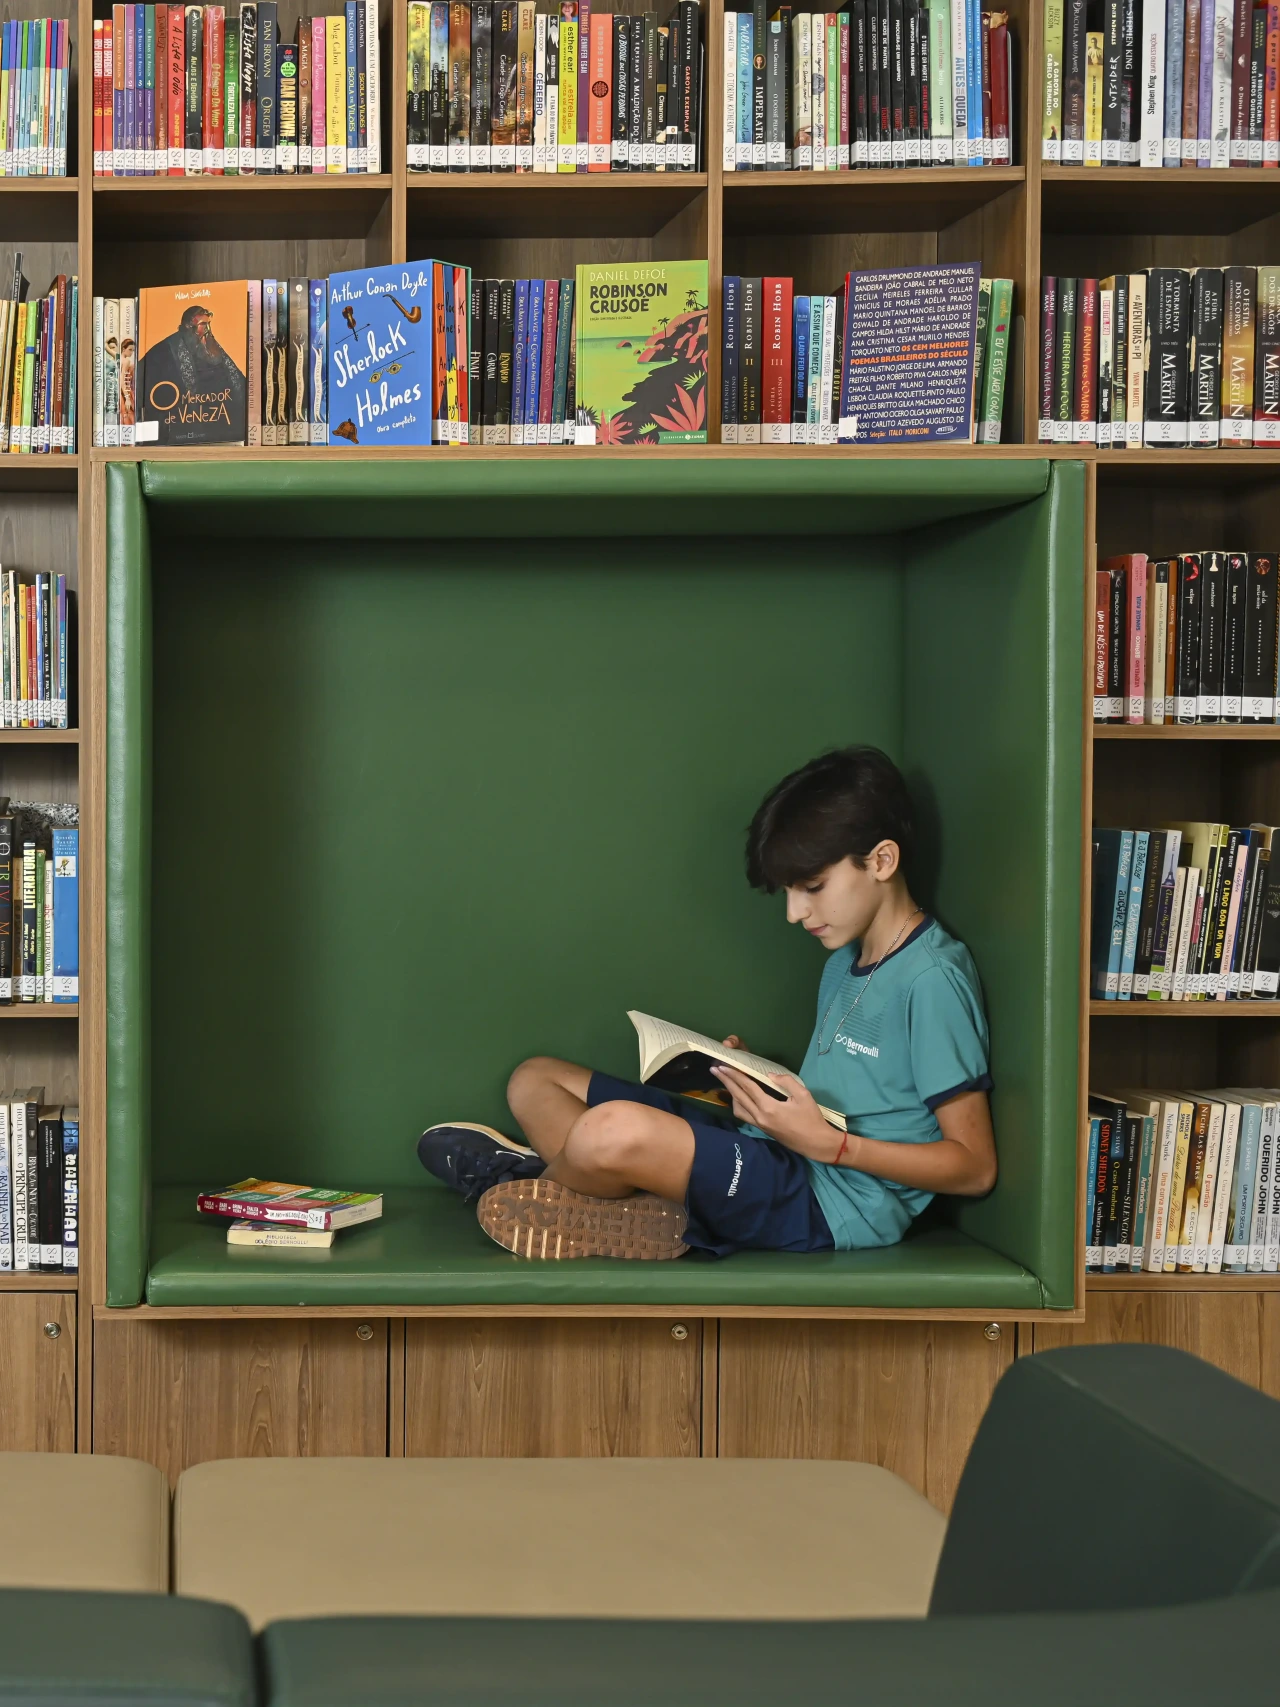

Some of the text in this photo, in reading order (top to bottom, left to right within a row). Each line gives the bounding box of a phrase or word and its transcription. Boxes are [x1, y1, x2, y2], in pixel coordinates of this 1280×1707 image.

[263, 20, 272, 42] DAN
[172, 36, 182, 59] Lista
[173, 63, 183, 73] do
[536, 73, 545, 115] CÉREBRO
[955, 58, 966, 128] ANTES QUEDA
[1053, 98, 1058, 108] DO
[1147, 75, 1157, 115] Stephen King
[261, 97, 272, 136] ORIGEM
[590, 269, 666, 282] DANIEL DEFOE
[856, 274, 877, 283] CARLOS
[878, 273, 913, 281] DRUMMOND
[922, 270, 950, 278] ANDRADE
[885, 281, 901, 291] JOÃO
[904, 280, 925, 288] CABRAL
[1165, 281, 1172, 292] DE
[331, 272, 428, 304] Arthur Conan Doyle
[590, 283, 667, 299] ROBINSON
[727, 283, 735, 311] HOBB
[773, 283, 782, 311] HOBB
[855, 292, 878, 302] CECÍLIA
[590, 295, 649, 314] CRUSOÉ
[854, 302, 880, 310] VINICIUS
[1132, 302, 1142, 344] AVENTURAS
[334, 321, 407, 387] Sherlock
[929, 341, 968, 349] MELHORES
[1062, 331, 1071, 376] HERDEIRA
[881, 353, 926, 363] BRASILEIROS
[940, 350, 968, 358] SÉCULO
[1162, 353, 1177, 415] MARTIN
[1231, 356, 1245, 417] MARTIN
[150, 381, 180, 411] O
[356, 382, 421, 428] Holmes
[1060, 390, 1069, 419] FOGO
[165, 411, 176, 424] de
[392, 413, 416, 428] completa
[24, 849, 35, 909] LITERATURA
[1221, 888, 1230, 906] LADO
[1219, 909, 1227, 926] BOM
[1216, 930, 1225, 940] DA
[1214, 943, 1224, 958] VIDA
[848, 1038, 879, 1058] Bernoulli
[1097, 1124, 1110, 1192] SIDNEY SHELDON
[1258, 1135, 1271, 1214] QUERIDO JOHN
